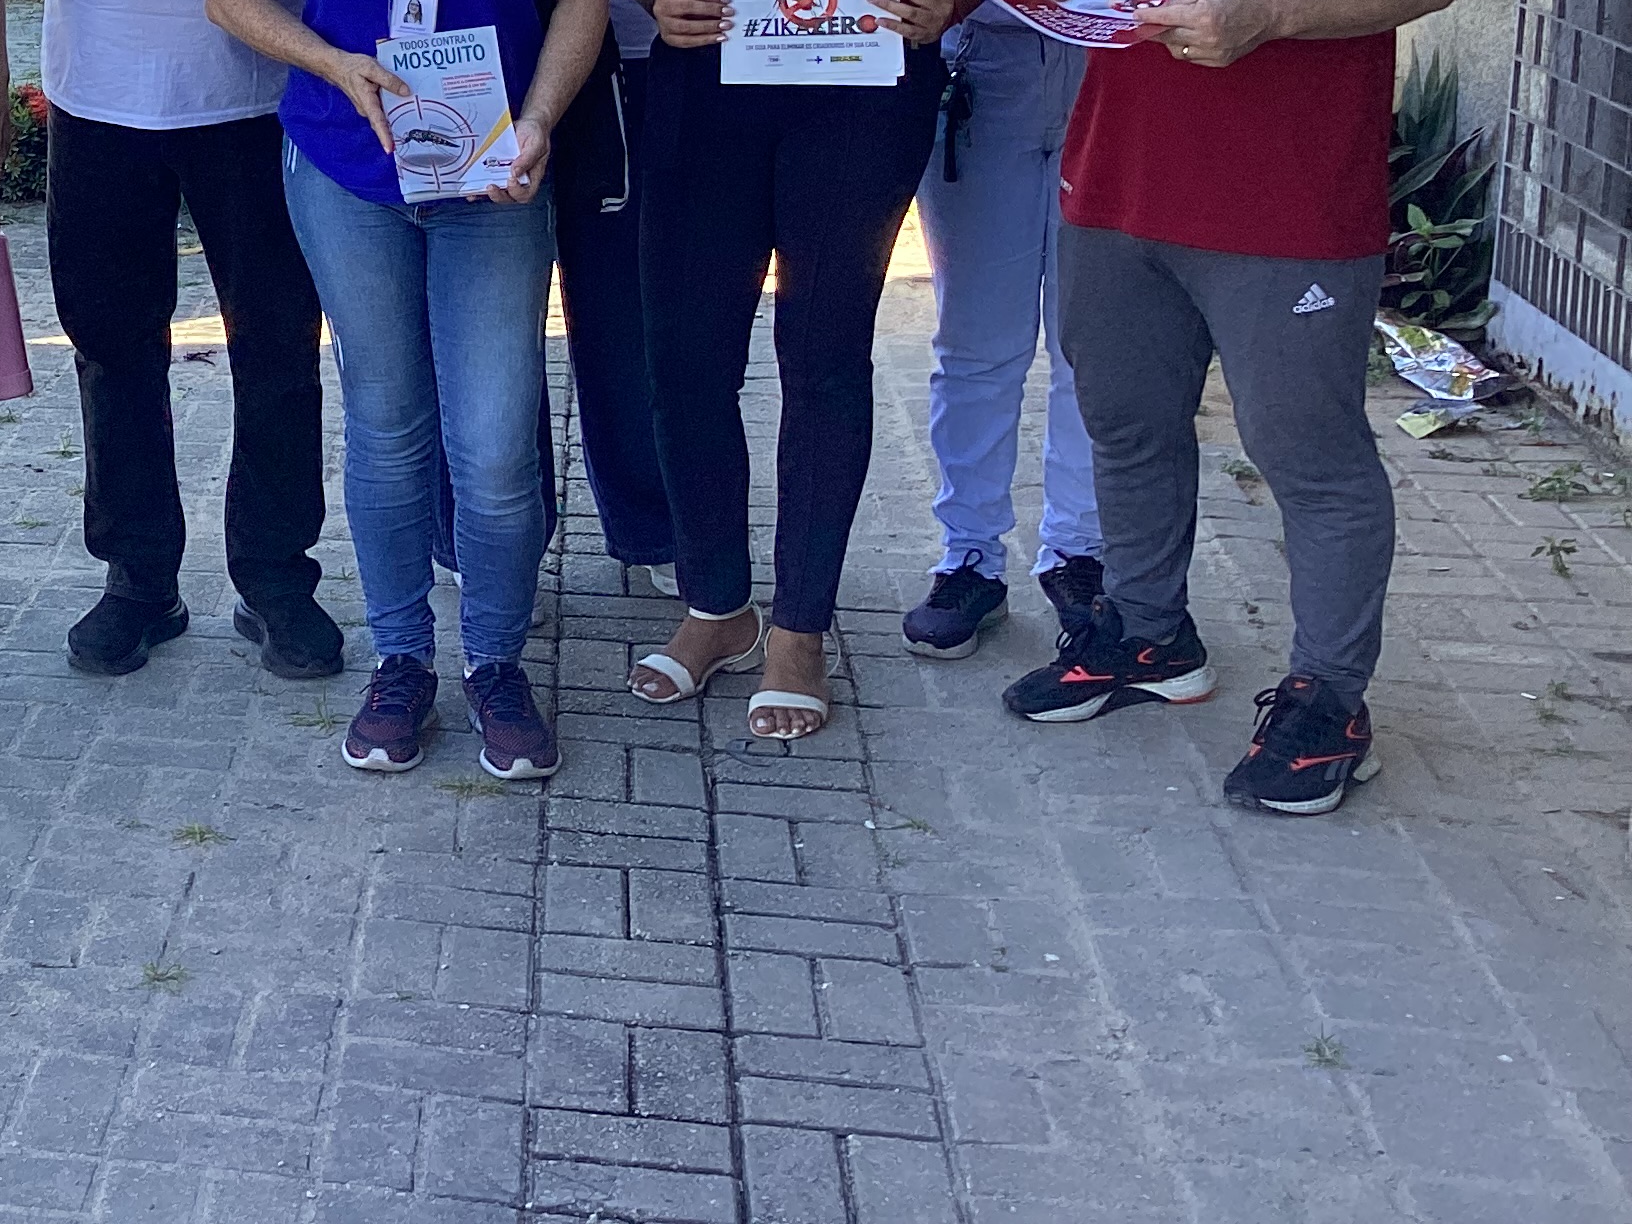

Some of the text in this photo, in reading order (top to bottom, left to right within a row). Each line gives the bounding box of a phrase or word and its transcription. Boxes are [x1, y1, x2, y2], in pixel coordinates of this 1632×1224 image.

[399, 34, 474, 51] TODOS CONTRA O
[393, 44, 486, 71] MOSQUITO
[1292, 297, 1335, 314] adidas
